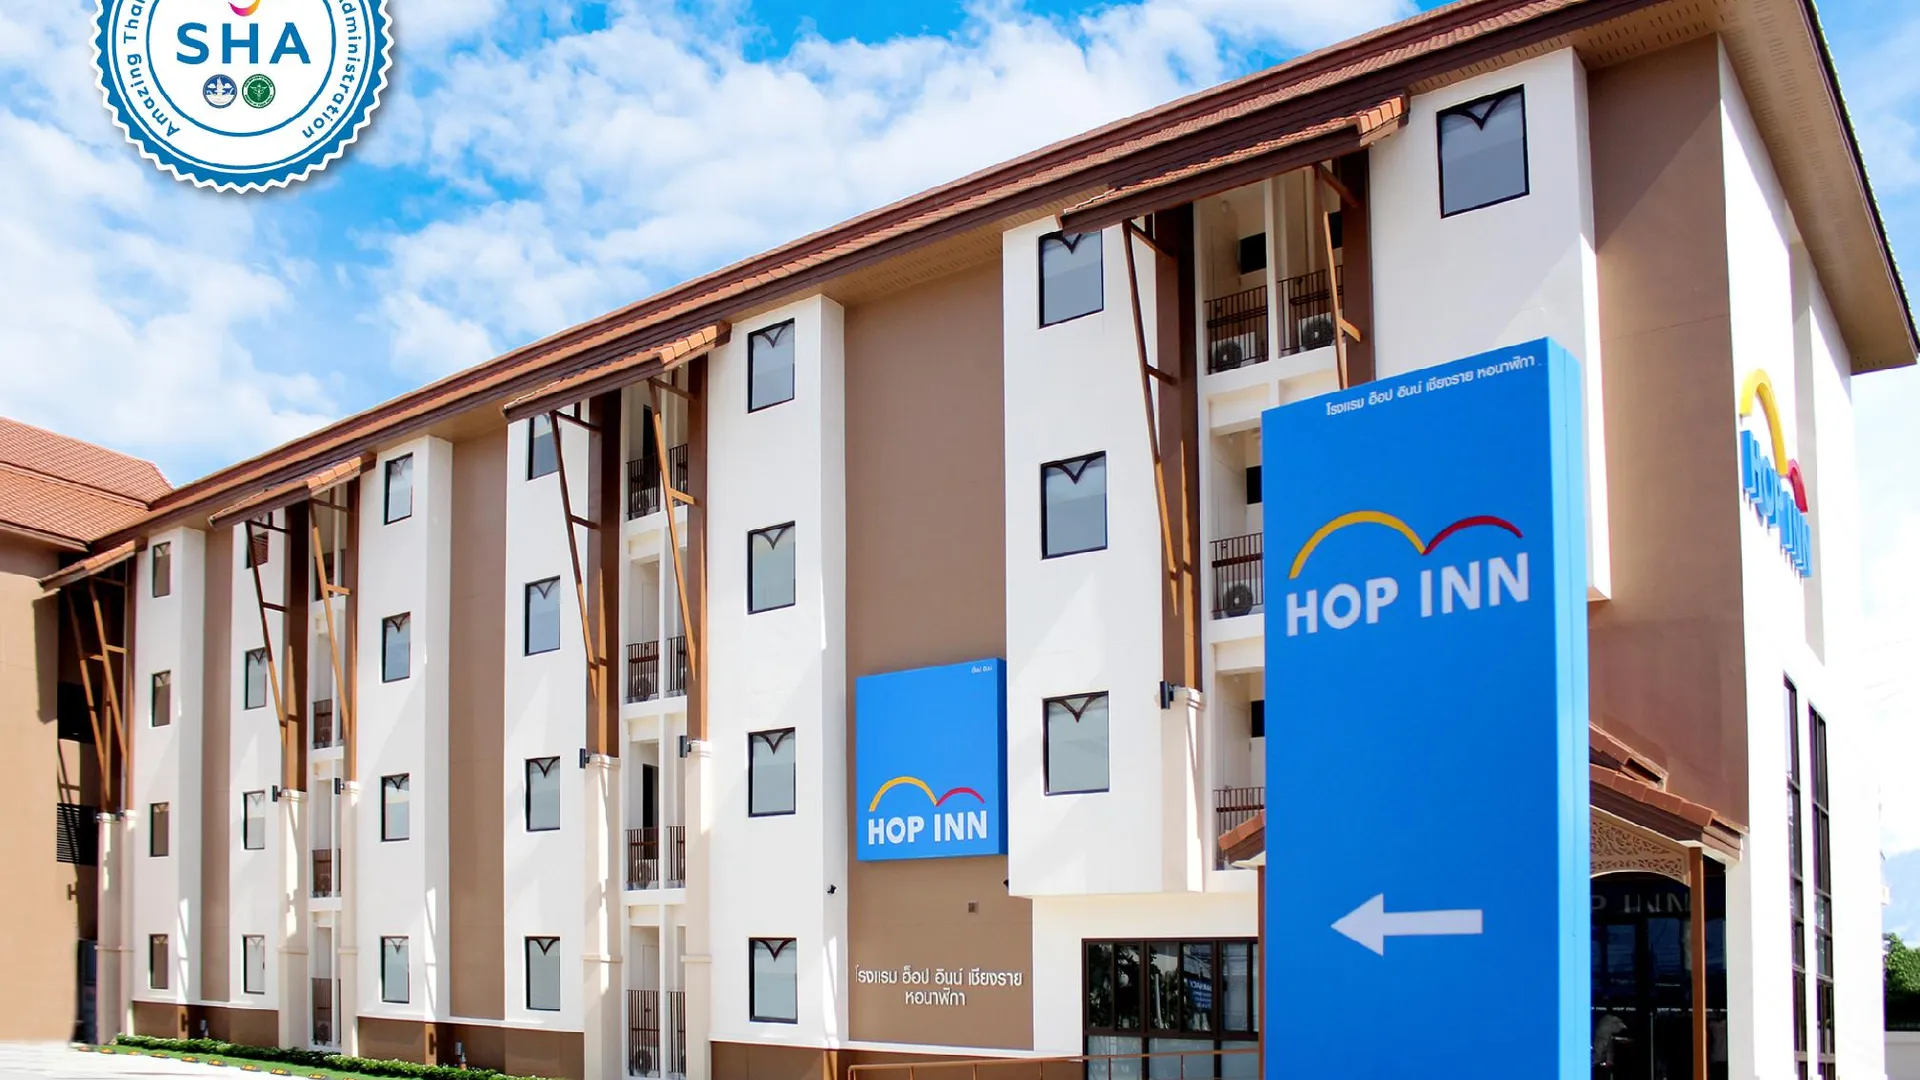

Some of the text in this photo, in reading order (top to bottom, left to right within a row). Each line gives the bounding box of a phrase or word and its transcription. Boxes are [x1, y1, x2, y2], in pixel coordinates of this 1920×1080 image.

[1325, 396, 1365, 417] โรงแรม
[1426, 372, 1474, 393] เชียงราย
[1477, 355, 1535, 379] หอนาฬิกา
[1286, 552, 1529, 637] HOP INN
[868, 810, 988, 845] HOP INN
[855, 964, 1023, 987] โรงแรม ฮ็อป อินน์ เชียงราย
[905, 987, 966, 1006] หอนาฬิกา
